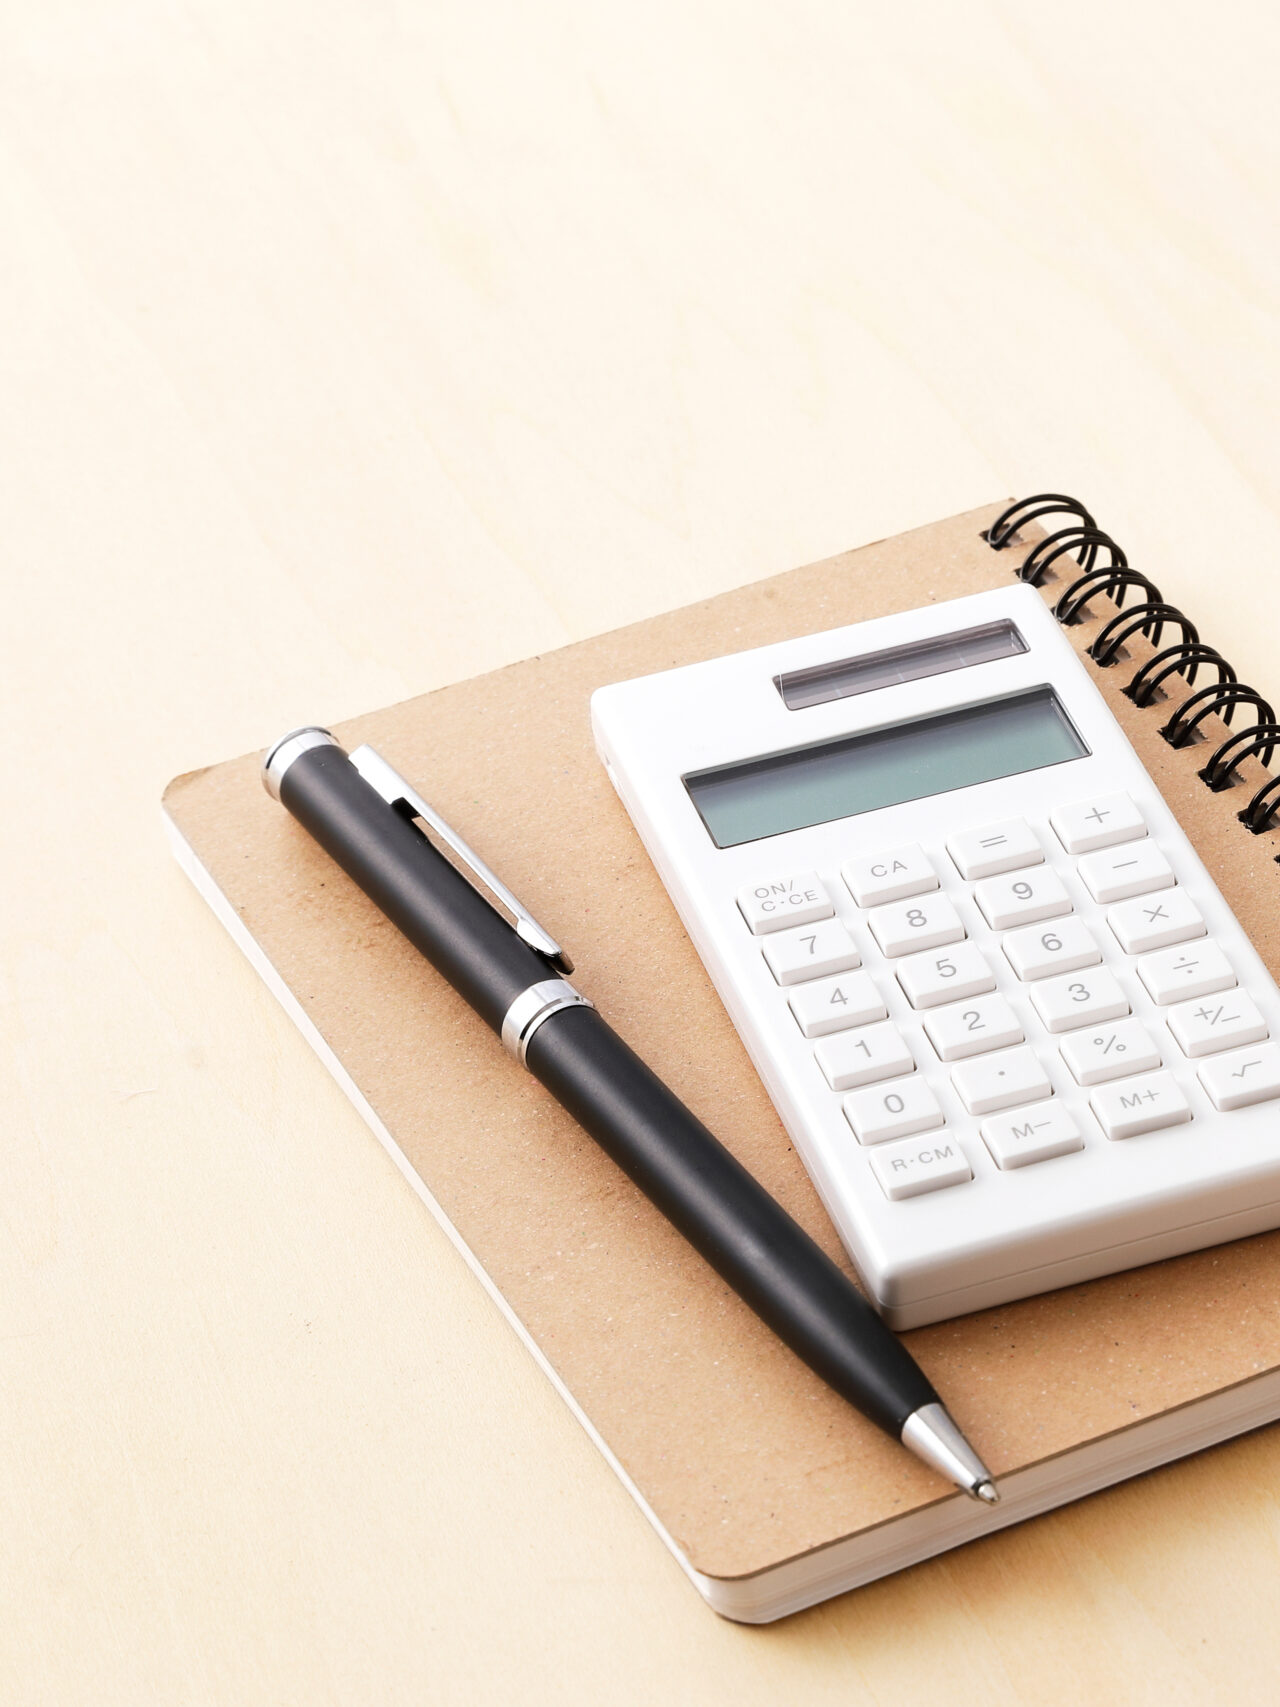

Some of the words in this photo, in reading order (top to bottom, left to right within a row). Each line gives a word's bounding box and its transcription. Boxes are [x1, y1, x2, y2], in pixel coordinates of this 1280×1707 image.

[871, 860, 908, 877] CA
[753, 880, 795, 899] ON/
[1012, 882, 1033, 900] 9
[906, 909, 928, 927] 8
[799, 935, 816, 955] 7
[1041, 933, 1062, 951] 6
[936, 958, 957, 977] 5
[830, 987, 848, 1005] 4
[1069, 983, 1090, 1002] 3
[963, 1011, 986, 1031] 2
[854, 1040, 872, 1058] 1
[1093, 1035, 1126, 1054] %
[883, 1094, 904, 1113] 0
[1120, 1090, 1160, 1109] M+
